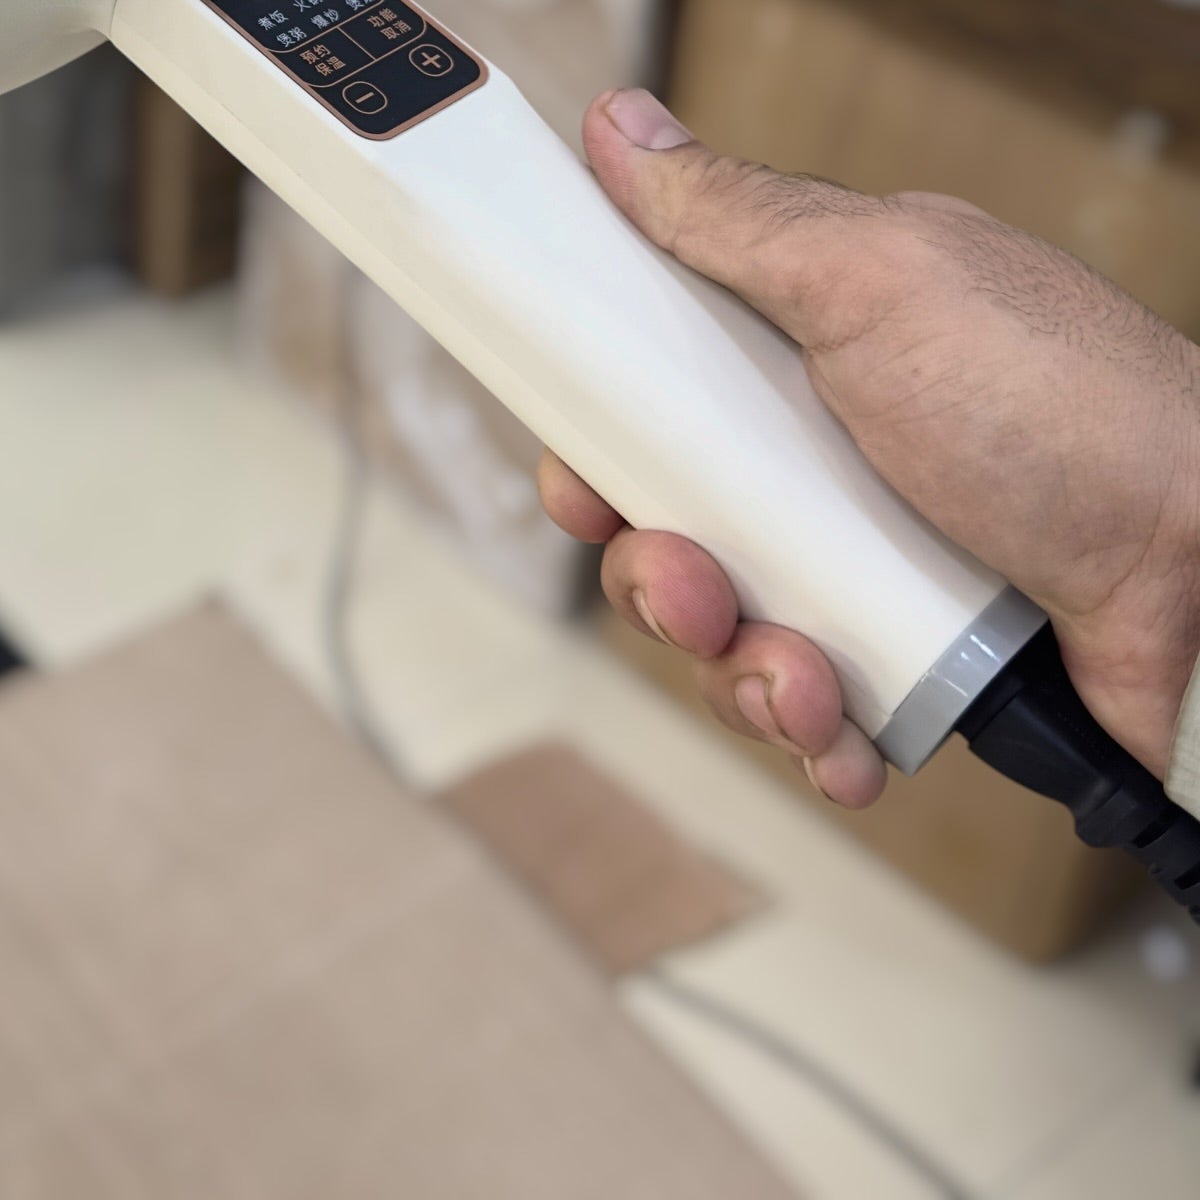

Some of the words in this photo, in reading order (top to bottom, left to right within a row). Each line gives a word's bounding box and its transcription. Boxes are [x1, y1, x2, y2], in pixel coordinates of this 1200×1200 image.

[257, 10, 288, 31] 煮饭
[276, 26, 307, 48] 煲粥
[310, 8, 339, 30] 爆炒
[367, 7, 398, 28] 功能
[380, 19, 412, 40] 取消
[299, 43, 331, 65] 预约
[315, 55, 346, 77] 保温
